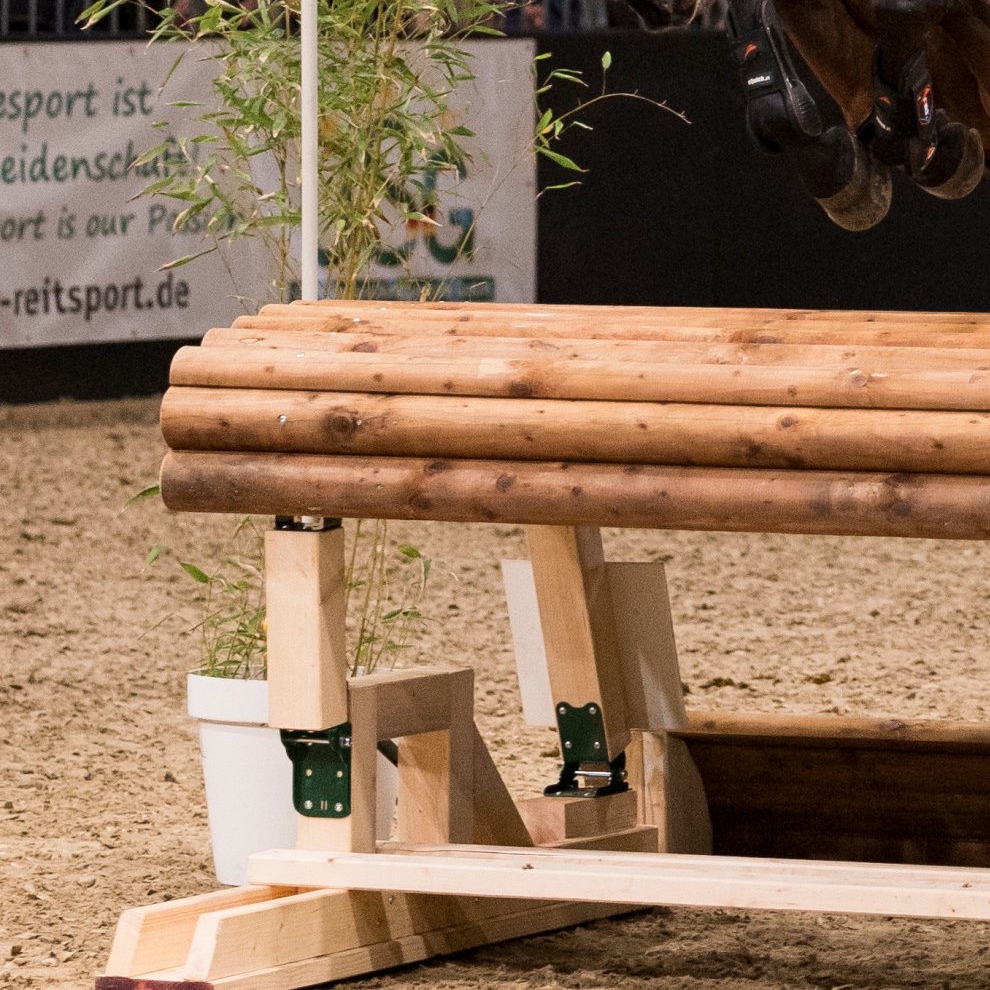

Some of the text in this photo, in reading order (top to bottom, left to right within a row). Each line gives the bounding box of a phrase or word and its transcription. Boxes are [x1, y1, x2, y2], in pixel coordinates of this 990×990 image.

[112, 75, 153, 117] ist
[57, 204, 78, 240] is
[85, 212, 136, 238] our
